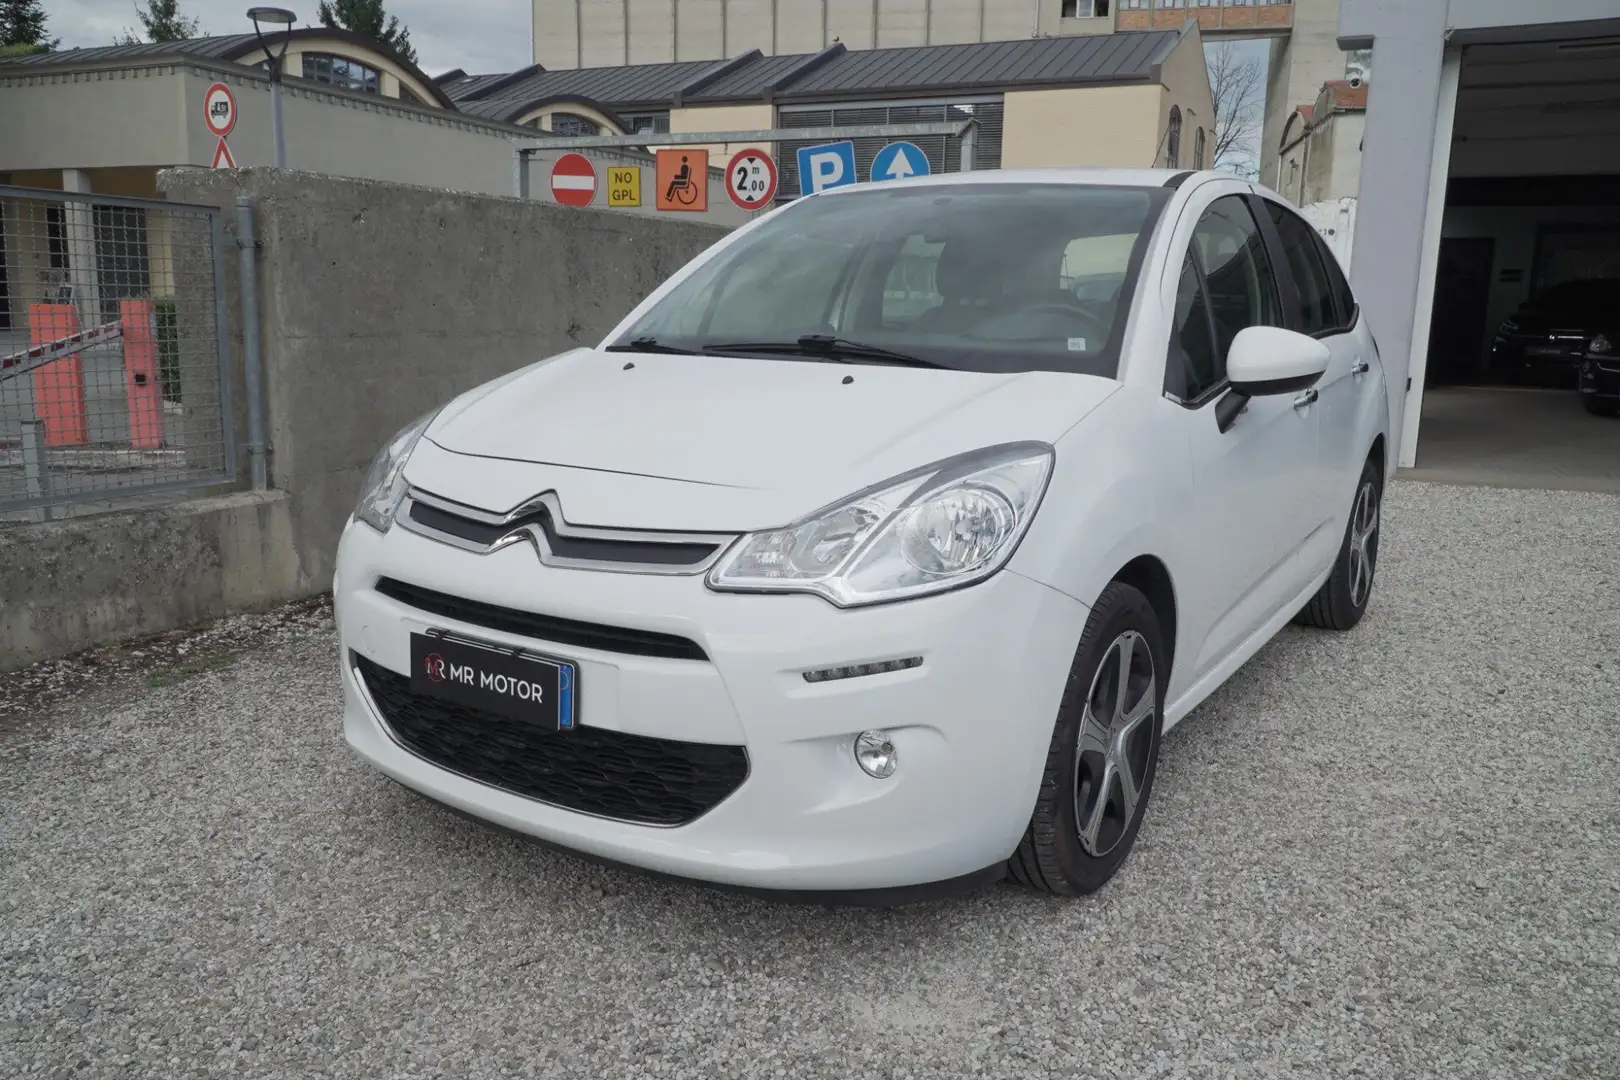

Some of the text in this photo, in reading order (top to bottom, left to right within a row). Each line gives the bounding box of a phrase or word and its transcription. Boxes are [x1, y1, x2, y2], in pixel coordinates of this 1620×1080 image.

[615, 172, 632, 184] NO
[810, 152, 843, 193] P
[612, 189, 636, 201] GPL
[450, 663, 543, 704] MR MOTOR
